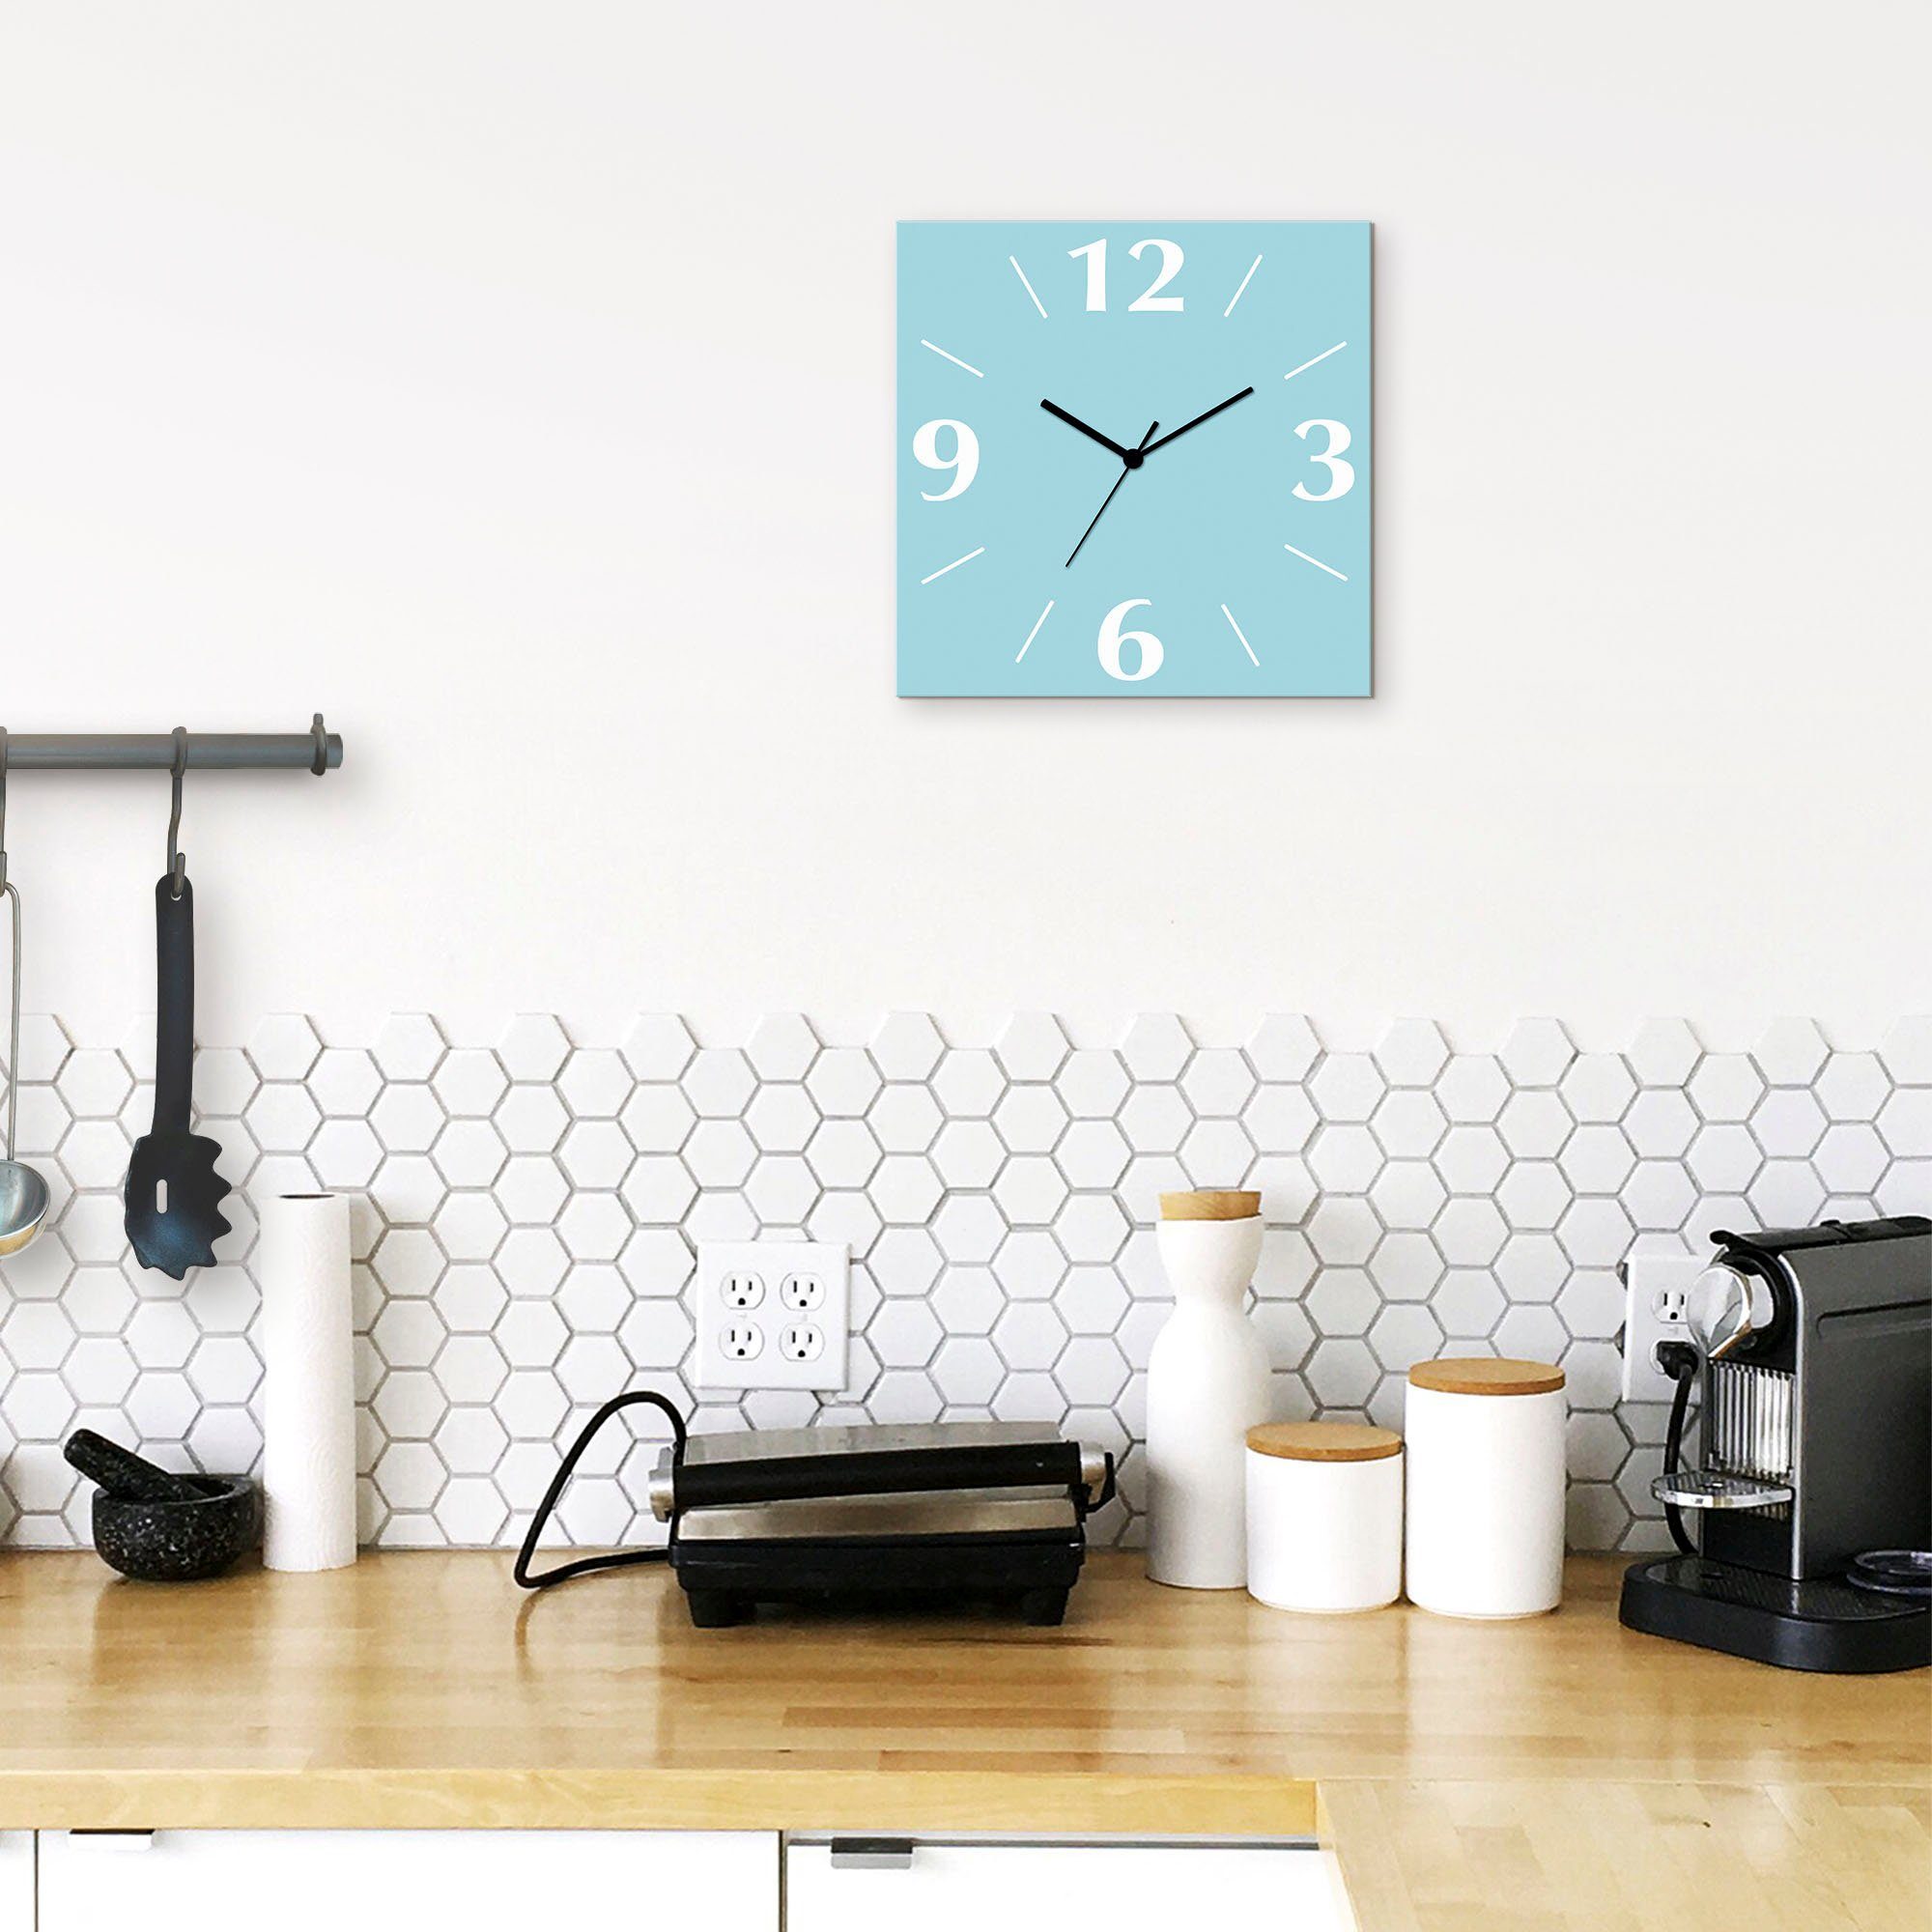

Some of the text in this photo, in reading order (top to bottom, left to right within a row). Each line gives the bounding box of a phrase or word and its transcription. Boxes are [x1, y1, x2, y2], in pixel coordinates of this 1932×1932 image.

[1066, 238, 1185, 312] 12
[912, 418, 980, 501] 9
[1291, 418, 1355, 501] 3
[1097, 598, 1165, 681] 6
